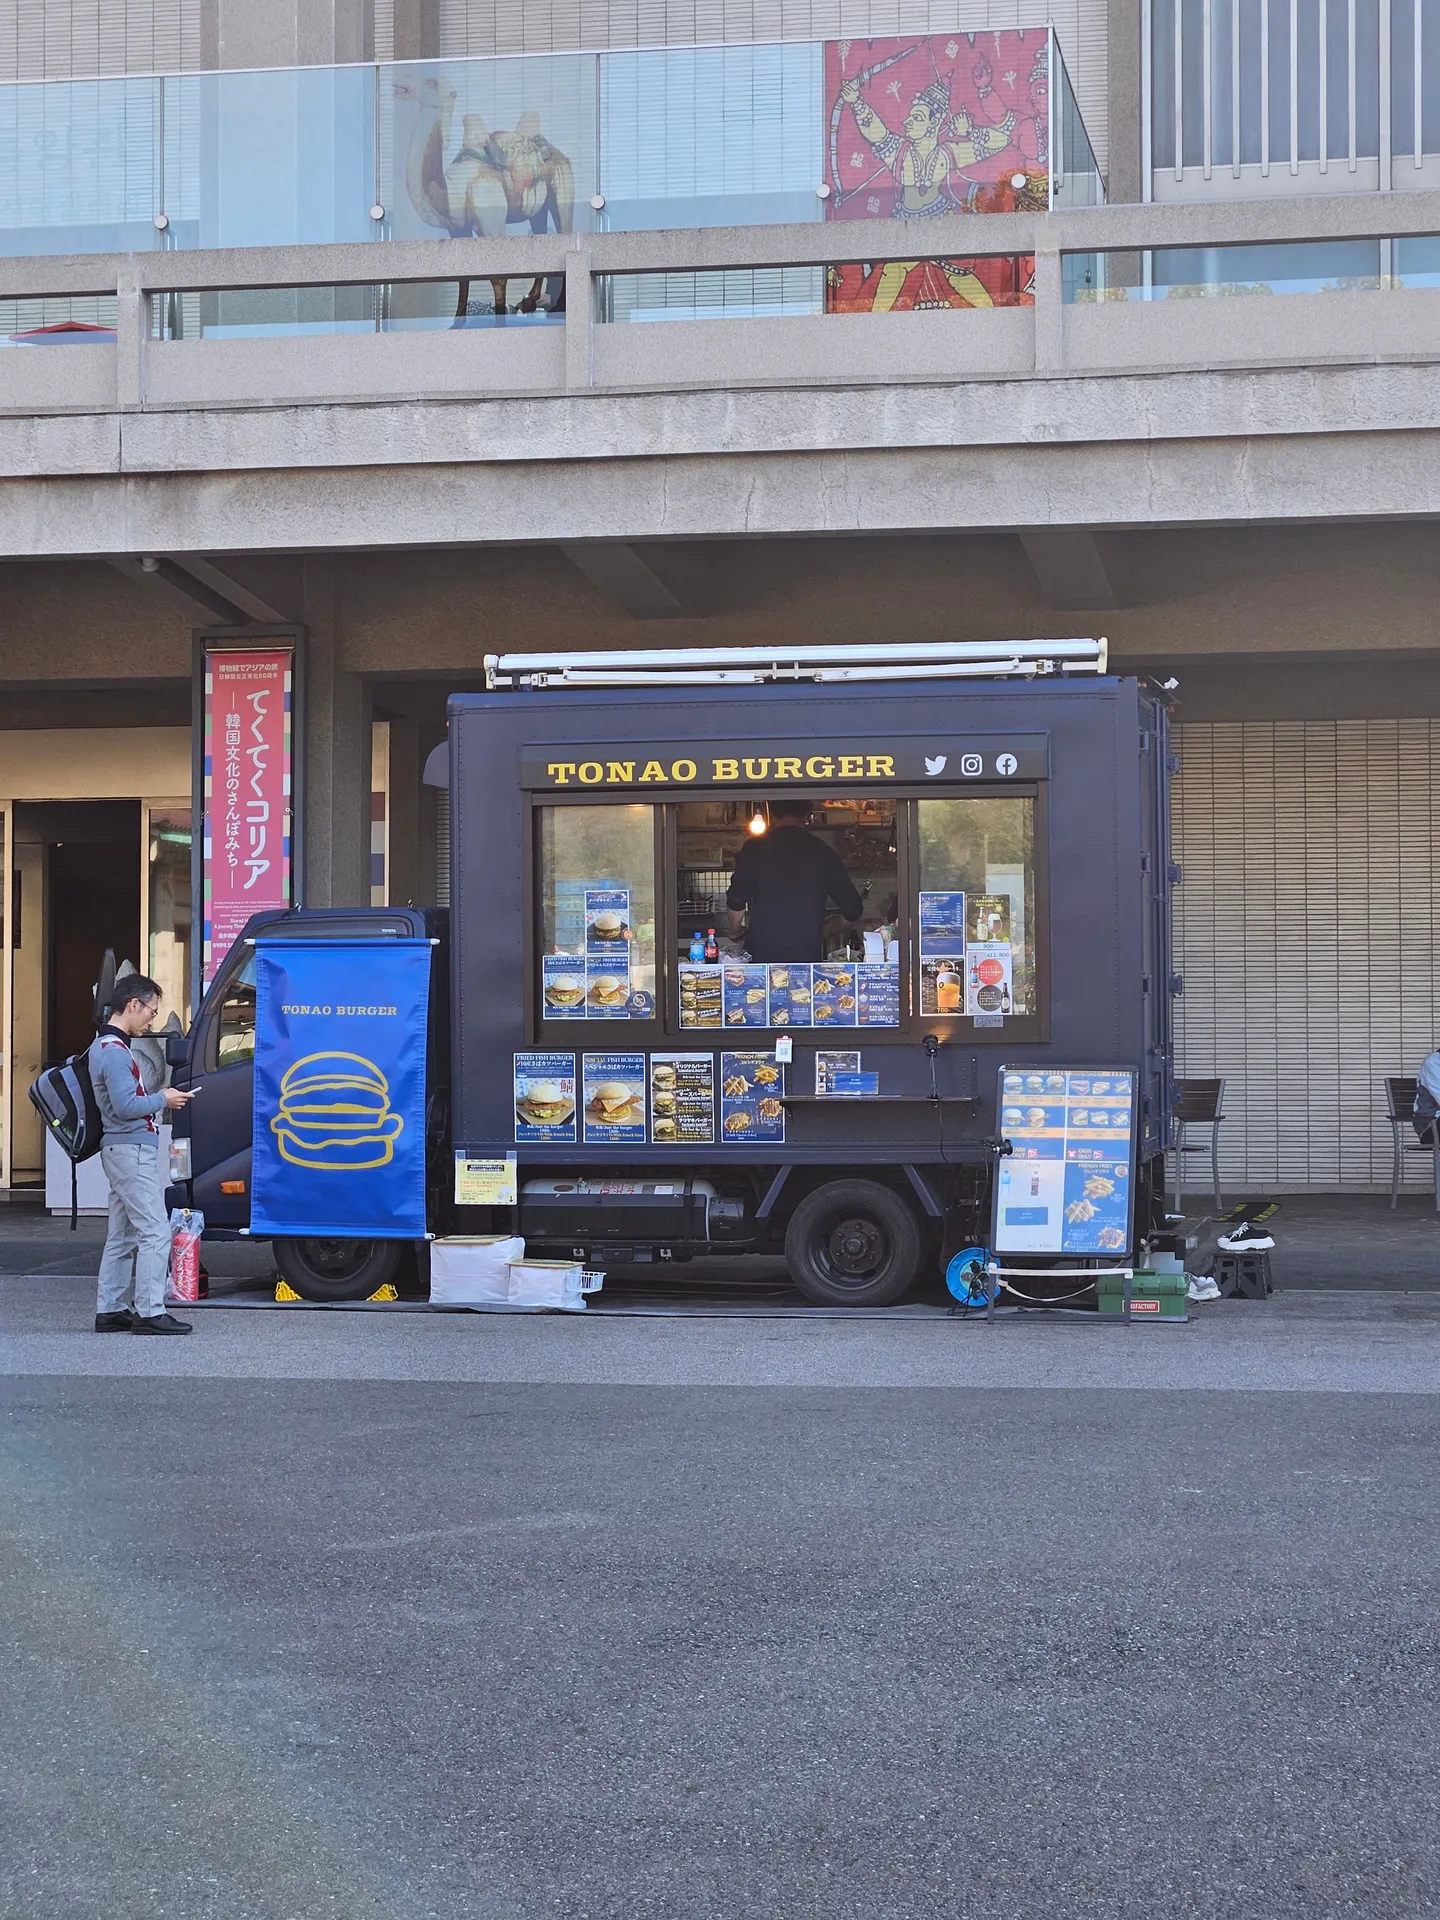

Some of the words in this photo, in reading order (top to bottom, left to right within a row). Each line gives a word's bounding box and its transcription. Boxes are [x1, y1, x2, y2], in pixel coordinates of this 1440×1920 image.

[547, 759, 697, 784] TONAO
[712, 755, 896, 781] BURGER
[243, 689, 270, 890] てくてくコリア
[281, 1005, 332, 1015] TONAO
[336, 1006, 397, 1016] BURGER
